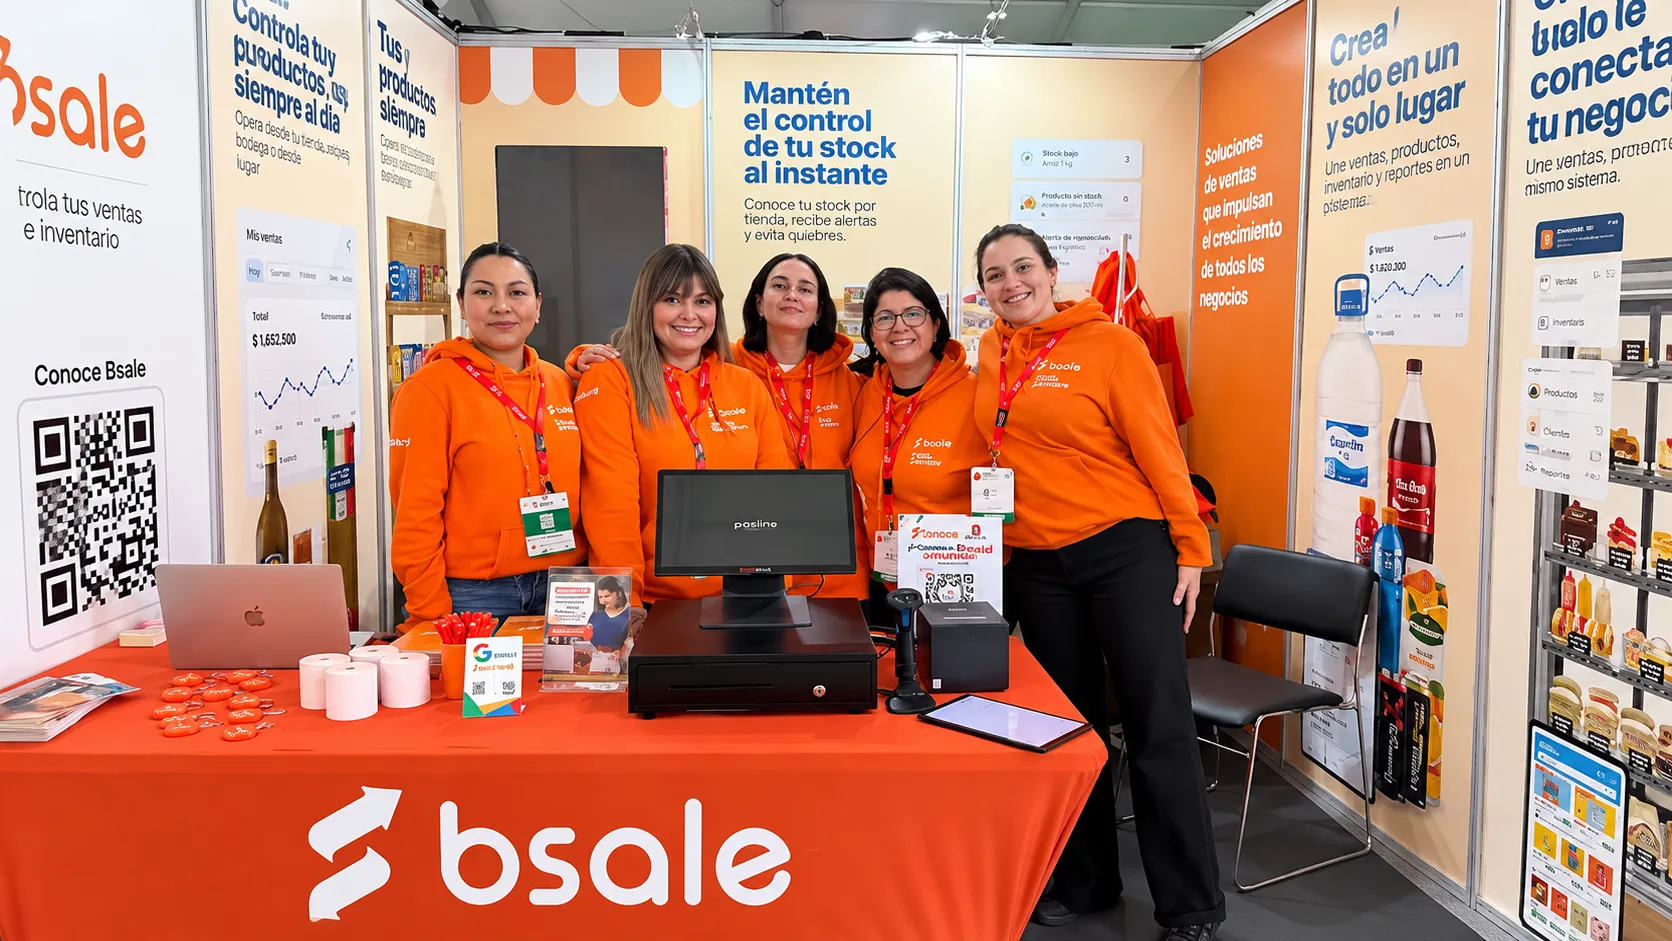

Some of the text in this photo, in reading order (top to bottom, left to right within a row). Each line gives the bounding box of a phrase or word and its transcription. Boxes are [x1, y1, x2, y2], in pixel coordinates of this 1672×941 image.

[233, 0, 336, 77] Controla tuy
[377, 19, 403, 64] Tus
[1330, 22, 1388, 67] Crea
[1328, 41, 1459, 106] todo en un
[234, 69, 302, 119] siempre
[305, 98, 317, 126] al
[320, 103, 340, 134] dia
[744, 81, 850, 105] Mantén
[235, 109, 263, 130] Opera
[292, 130, 300, 144] tu
[744, 108, 871, 132] el control
[1326, 80, 1466, 150] y solo lugar
[1527, 80, 1672, 145] tu negoc
[235, 132, 301, 164] bodega o desde
[744, 134, 897, 159] de tu stock
[1063, 150, 1079, 158] bajo
[1124, 155, 1130, 163] 3
[1204, 132, 1263, 166] Soluciones
[1325, 133, 1460, 176] Une ventas, productos,
[744, 160, 888, 185] al instante
[1324, 152, 1470, 195] inventario y reportes en un
[1526, 158, 1552, 175] Une
[1556, 150, 1607, 170] ventas,
[1204, 165, 1257, 194] de ventas
[1525, 170, 1620, 196] mismo sistema.
[62, 193, 88, 216] tus
[93, 201, 142, 224] ventas
[744, 198, 876, 214] Conoce tu stock por
[1202, 191, 1273, 225] que impulsan
[24, 219, 119, 249] e inventario
[744, 214, 877, 227] tienda, recibe alertas
[1202, 218, 1283, 250] el crecimiento
[246, 228, 283, 244] Mis ventas
[744, 229, 846, 243] y evita quiebres.
[1201, 253, 1265, 279] de todos los
[1369, 264, 1374, 273] $
[1555, 277, 1577, 285] Ventas
[1199, 286, 1248, 311] negocios
[252, 312, 269, 321] Total
[252, 333, 297, 348] $ 1,652,500
[34, 358, 146, 386] Conoce Bsale
[440, 798, 791, 906] bsale
